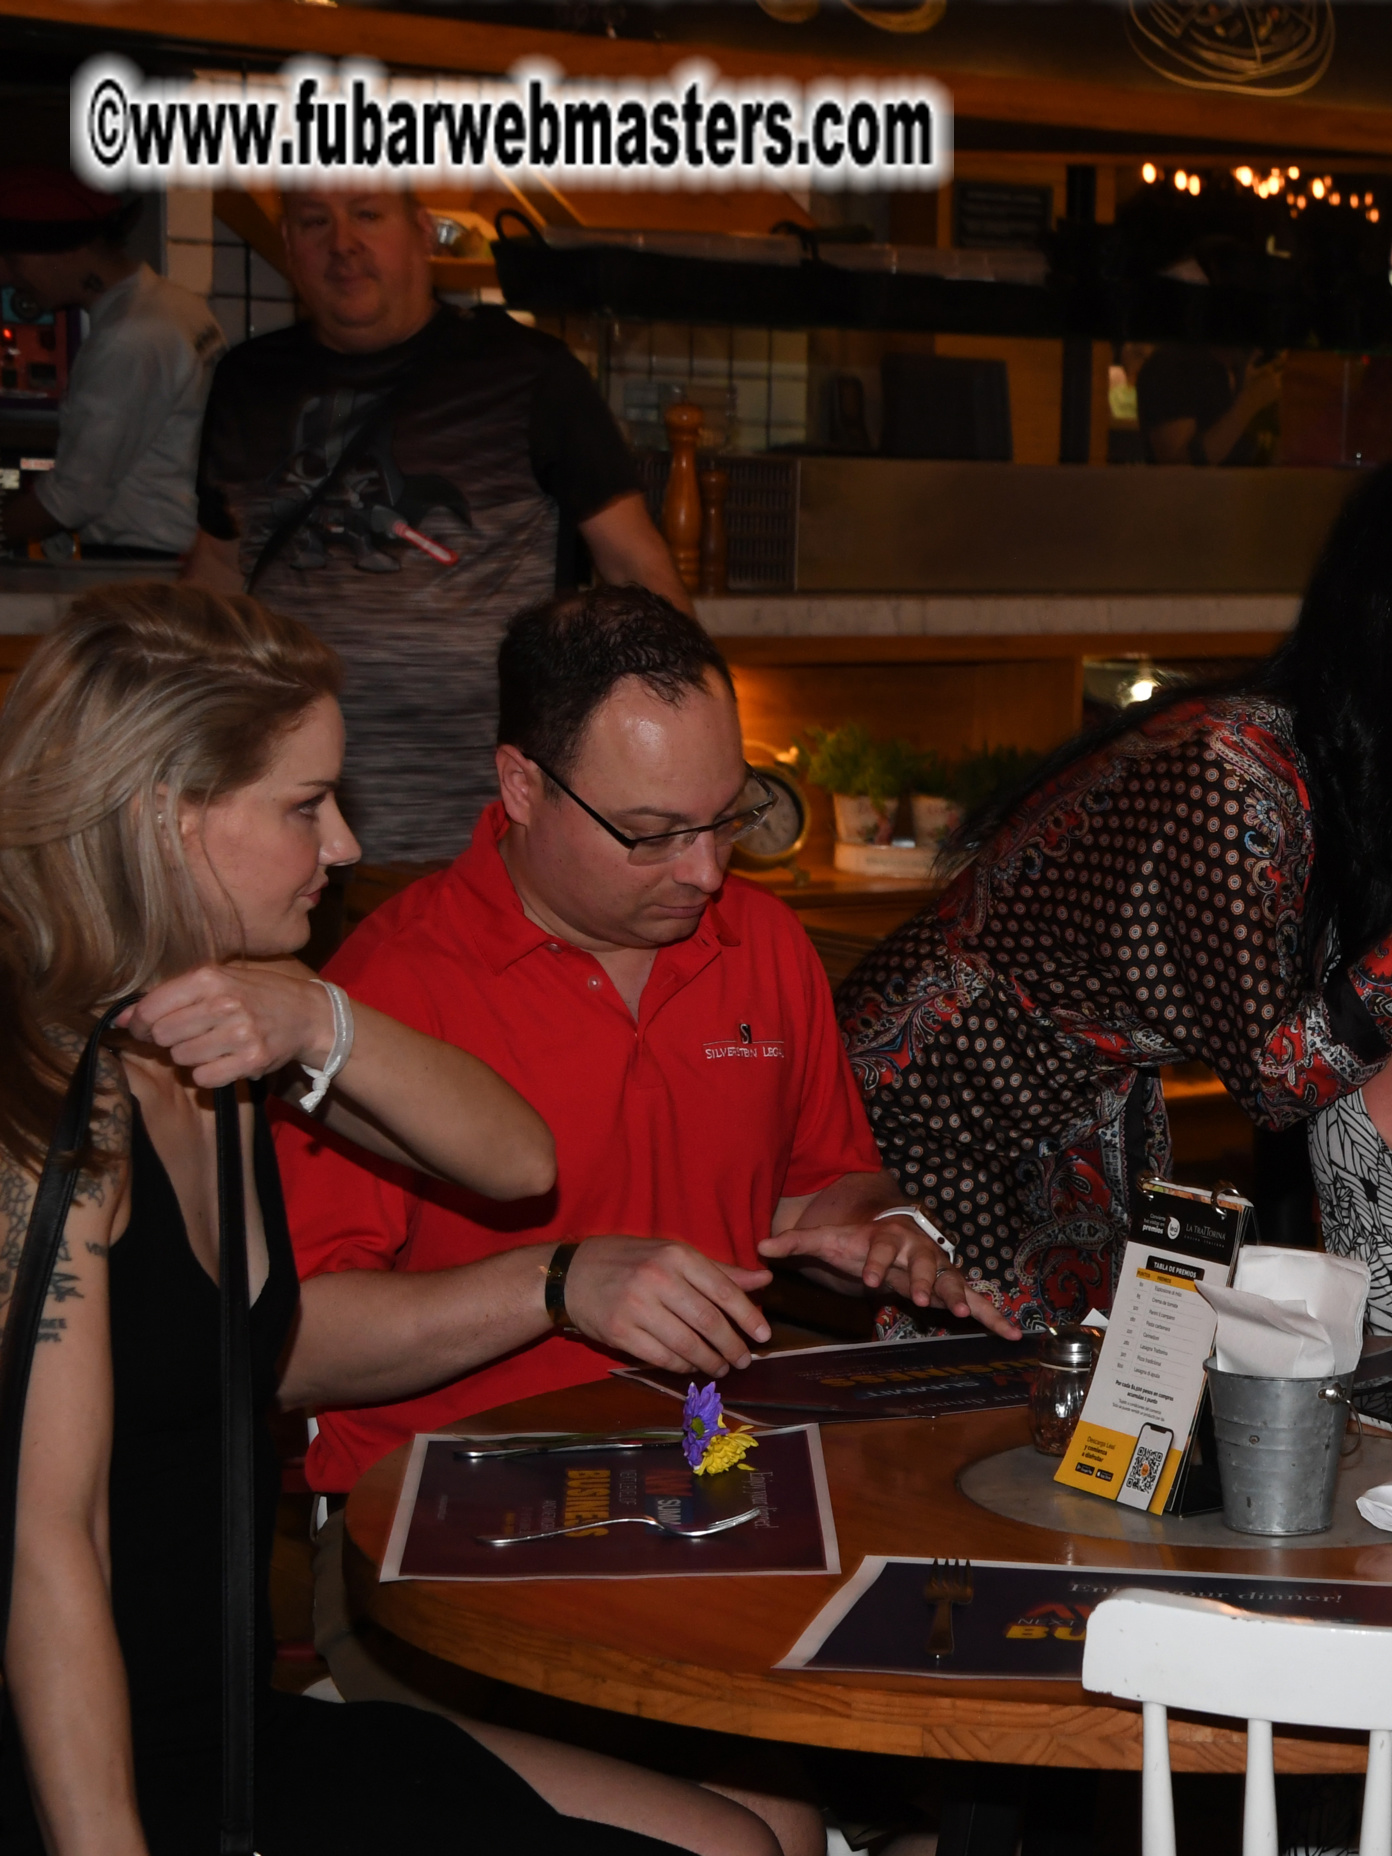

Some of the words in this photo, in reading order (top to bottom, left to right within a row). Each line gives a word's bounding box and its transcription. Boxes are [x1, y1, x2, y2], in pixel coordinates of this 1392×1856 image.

[1142, 1223, 1165, 1236] premios
[1185, 1224, 1194, 1232] LA
[1154, 1262, 1169, 1271] TABLA
[1176, 1267, 1197, 1279] PREMIOS
[865, 1381, 981, 1398] SUMMIT
[1147, 1397, 1158, 1405] punto
[1158, 1393, 1174, 1402] compras
